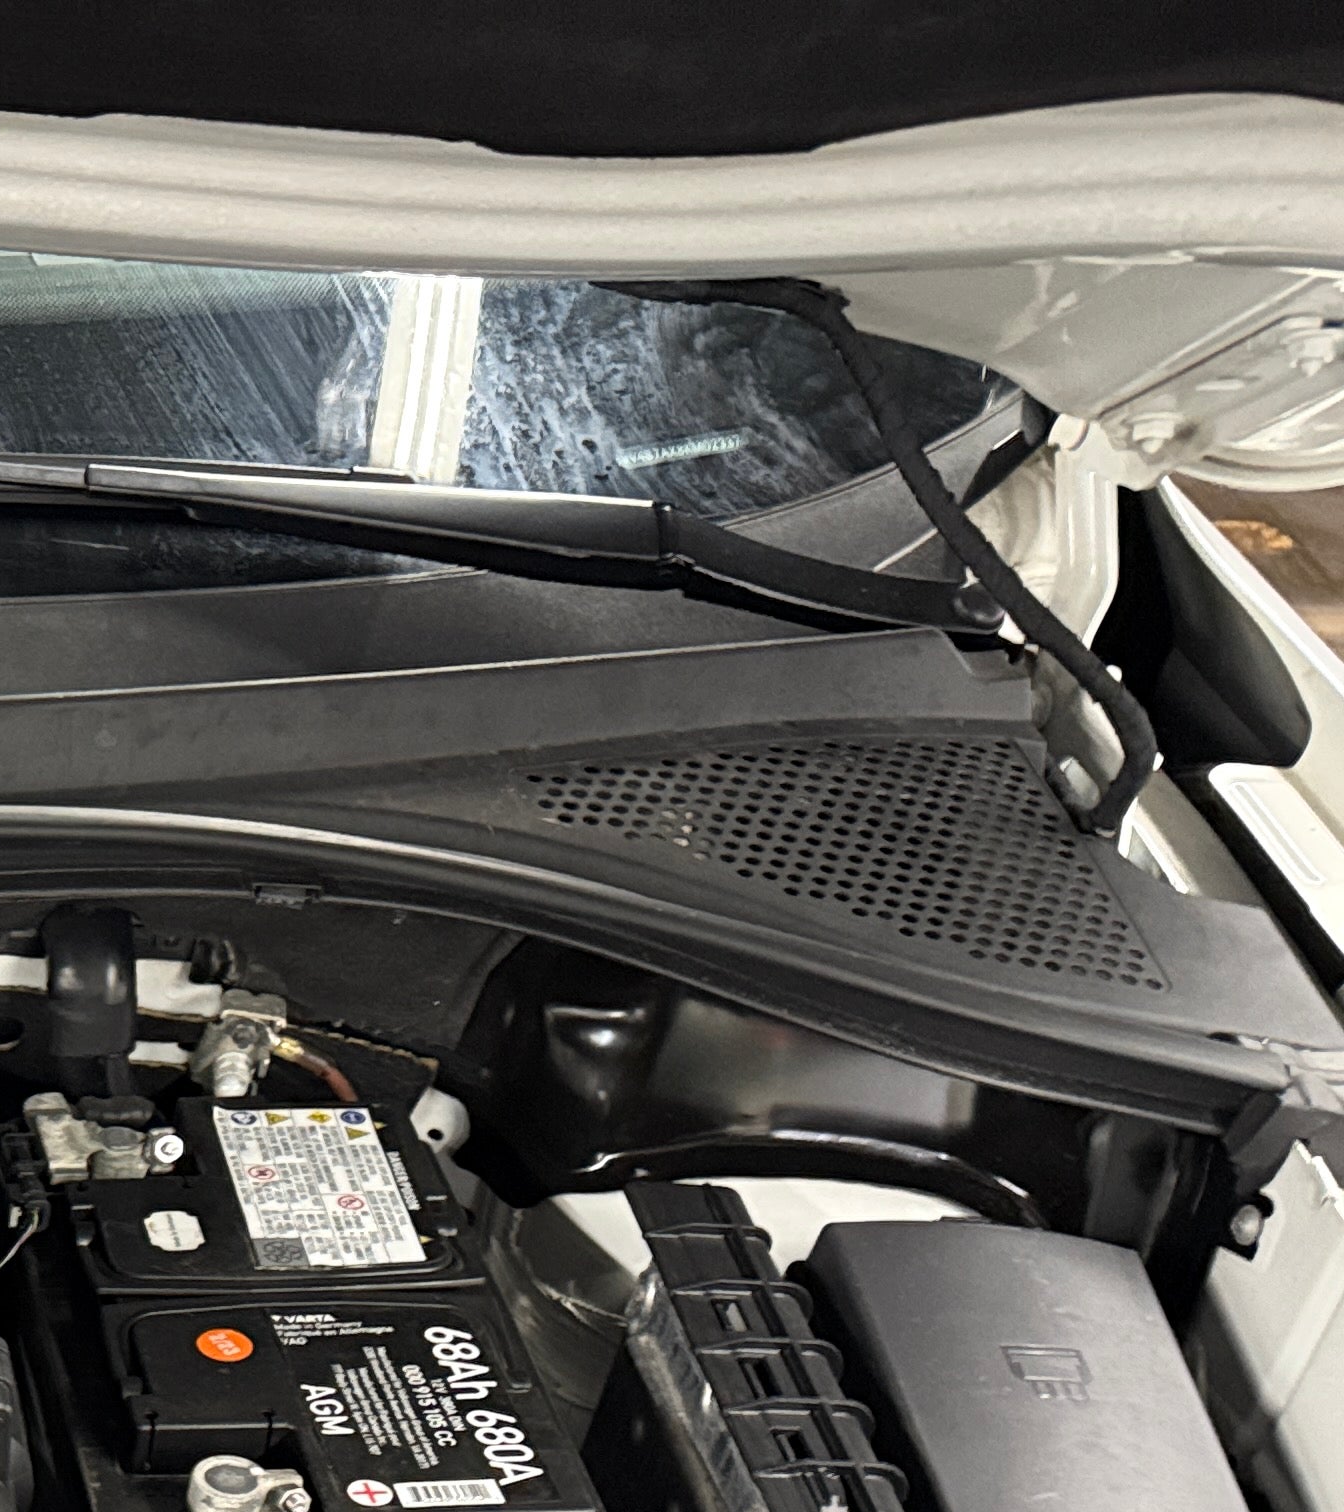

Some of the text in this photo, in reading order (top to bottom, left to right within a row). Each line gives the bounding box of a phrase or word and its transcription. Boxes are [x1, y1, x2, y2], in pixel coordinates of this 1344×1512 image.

[412, 1386, 438, 1407] 915
[423, 1326, 544, 1487] 68Ah 680A
[300, 1384, 355, 1435] AGM
[423, 1408, 449, 1429] 105
[434, 1430, 458, 1447] CC
